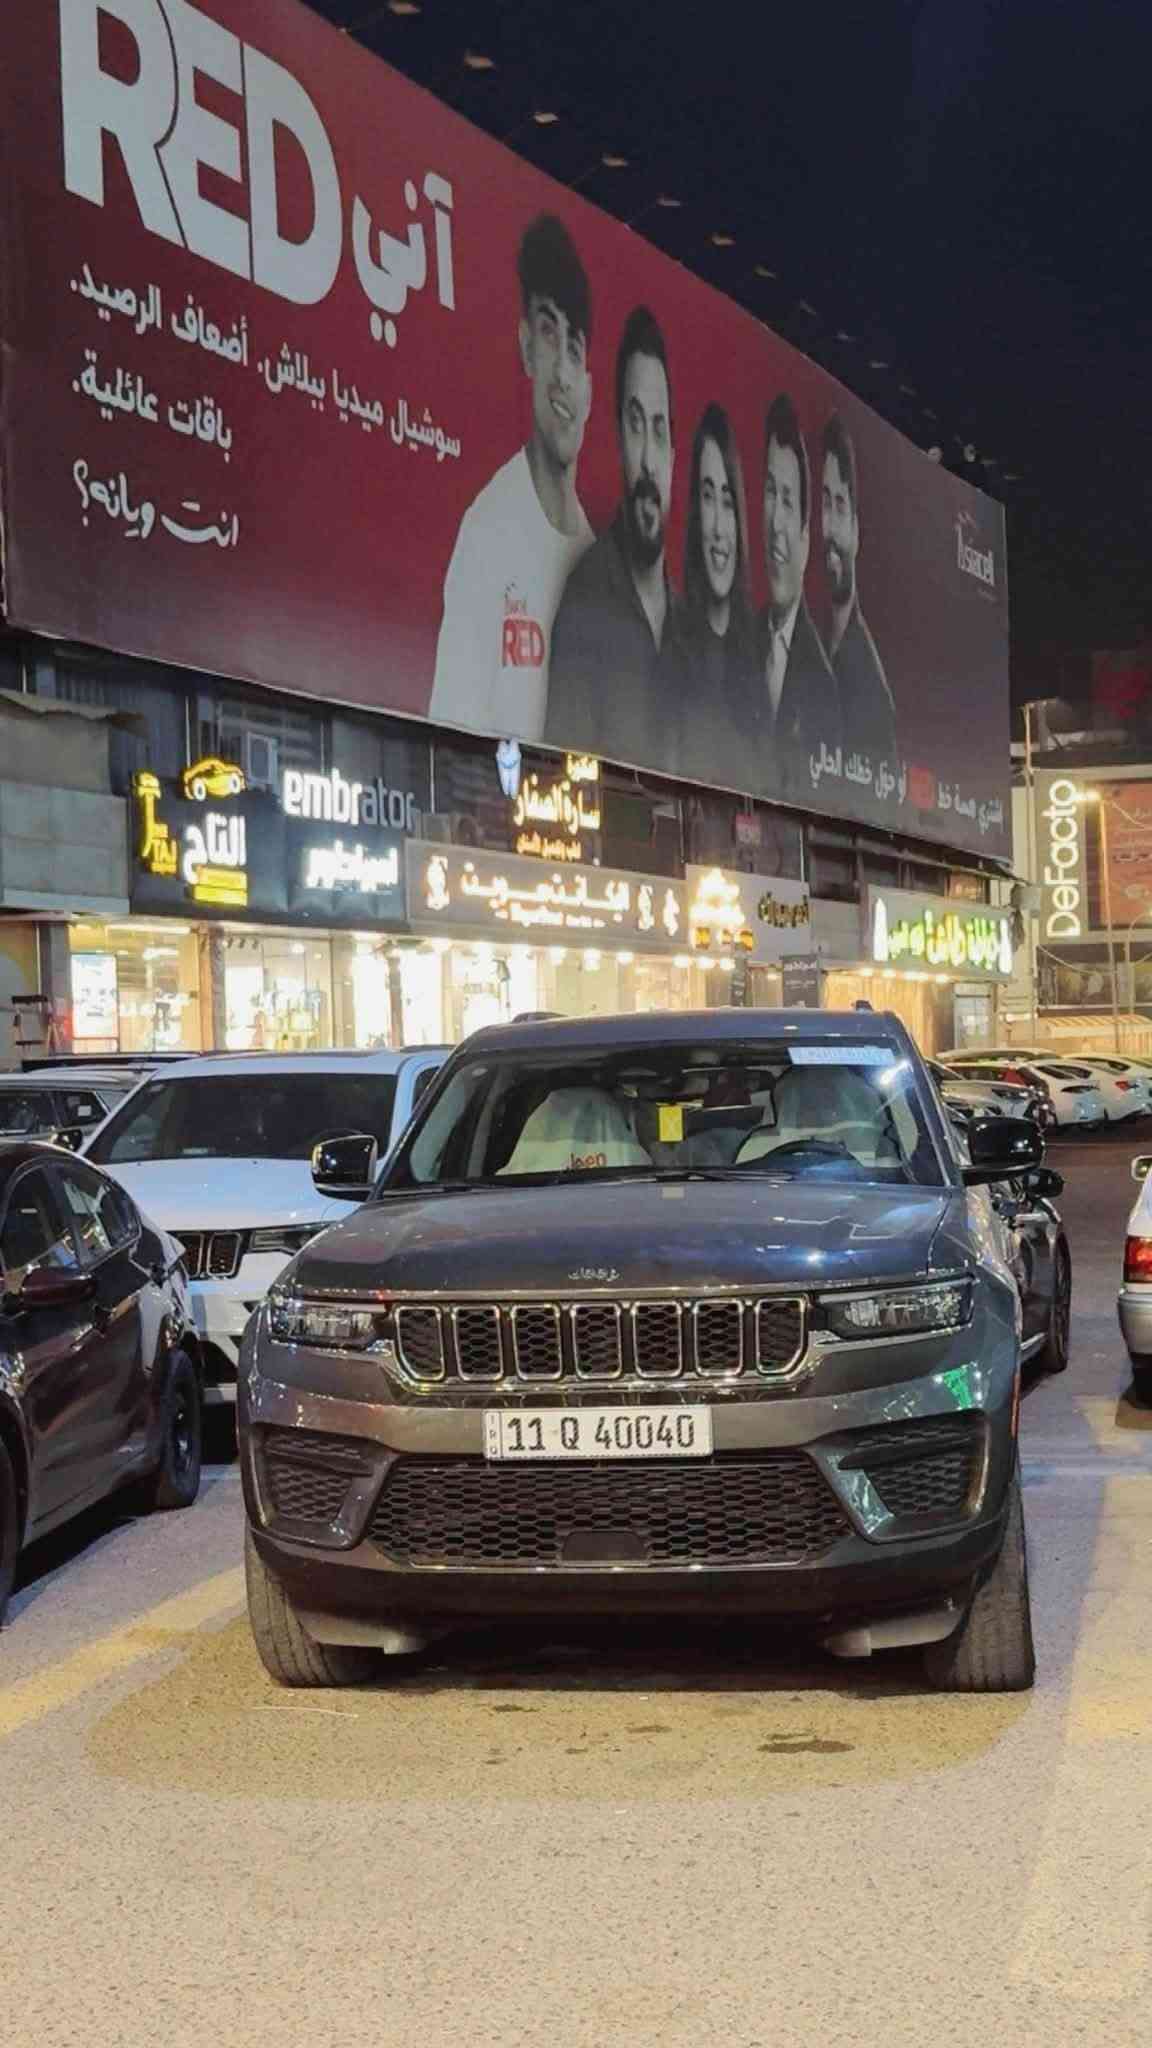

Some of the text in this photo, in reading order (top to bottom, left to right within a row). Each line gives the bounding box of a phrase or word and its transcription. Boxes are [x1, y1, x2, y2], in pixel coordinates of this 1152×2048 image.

[58, 0, 455, 347] آني RED
[70, 263, 162, 334] الرصيد.
[171, 294, 248, 366] أضعاف
[72, 349, 232, 463] باقات عائلية.
[332, 368, 384, 432] ميديا
[390, 398, 460, 462] سوشيال
[160, 501, 239, 547] انت
[502, 619, 545, 667] RED
[283, 767, 416, 831] embrator
[1043, 780, 1080, 937] DeFacto
[507, 1414, 695, 1451] 11 Q 40040
